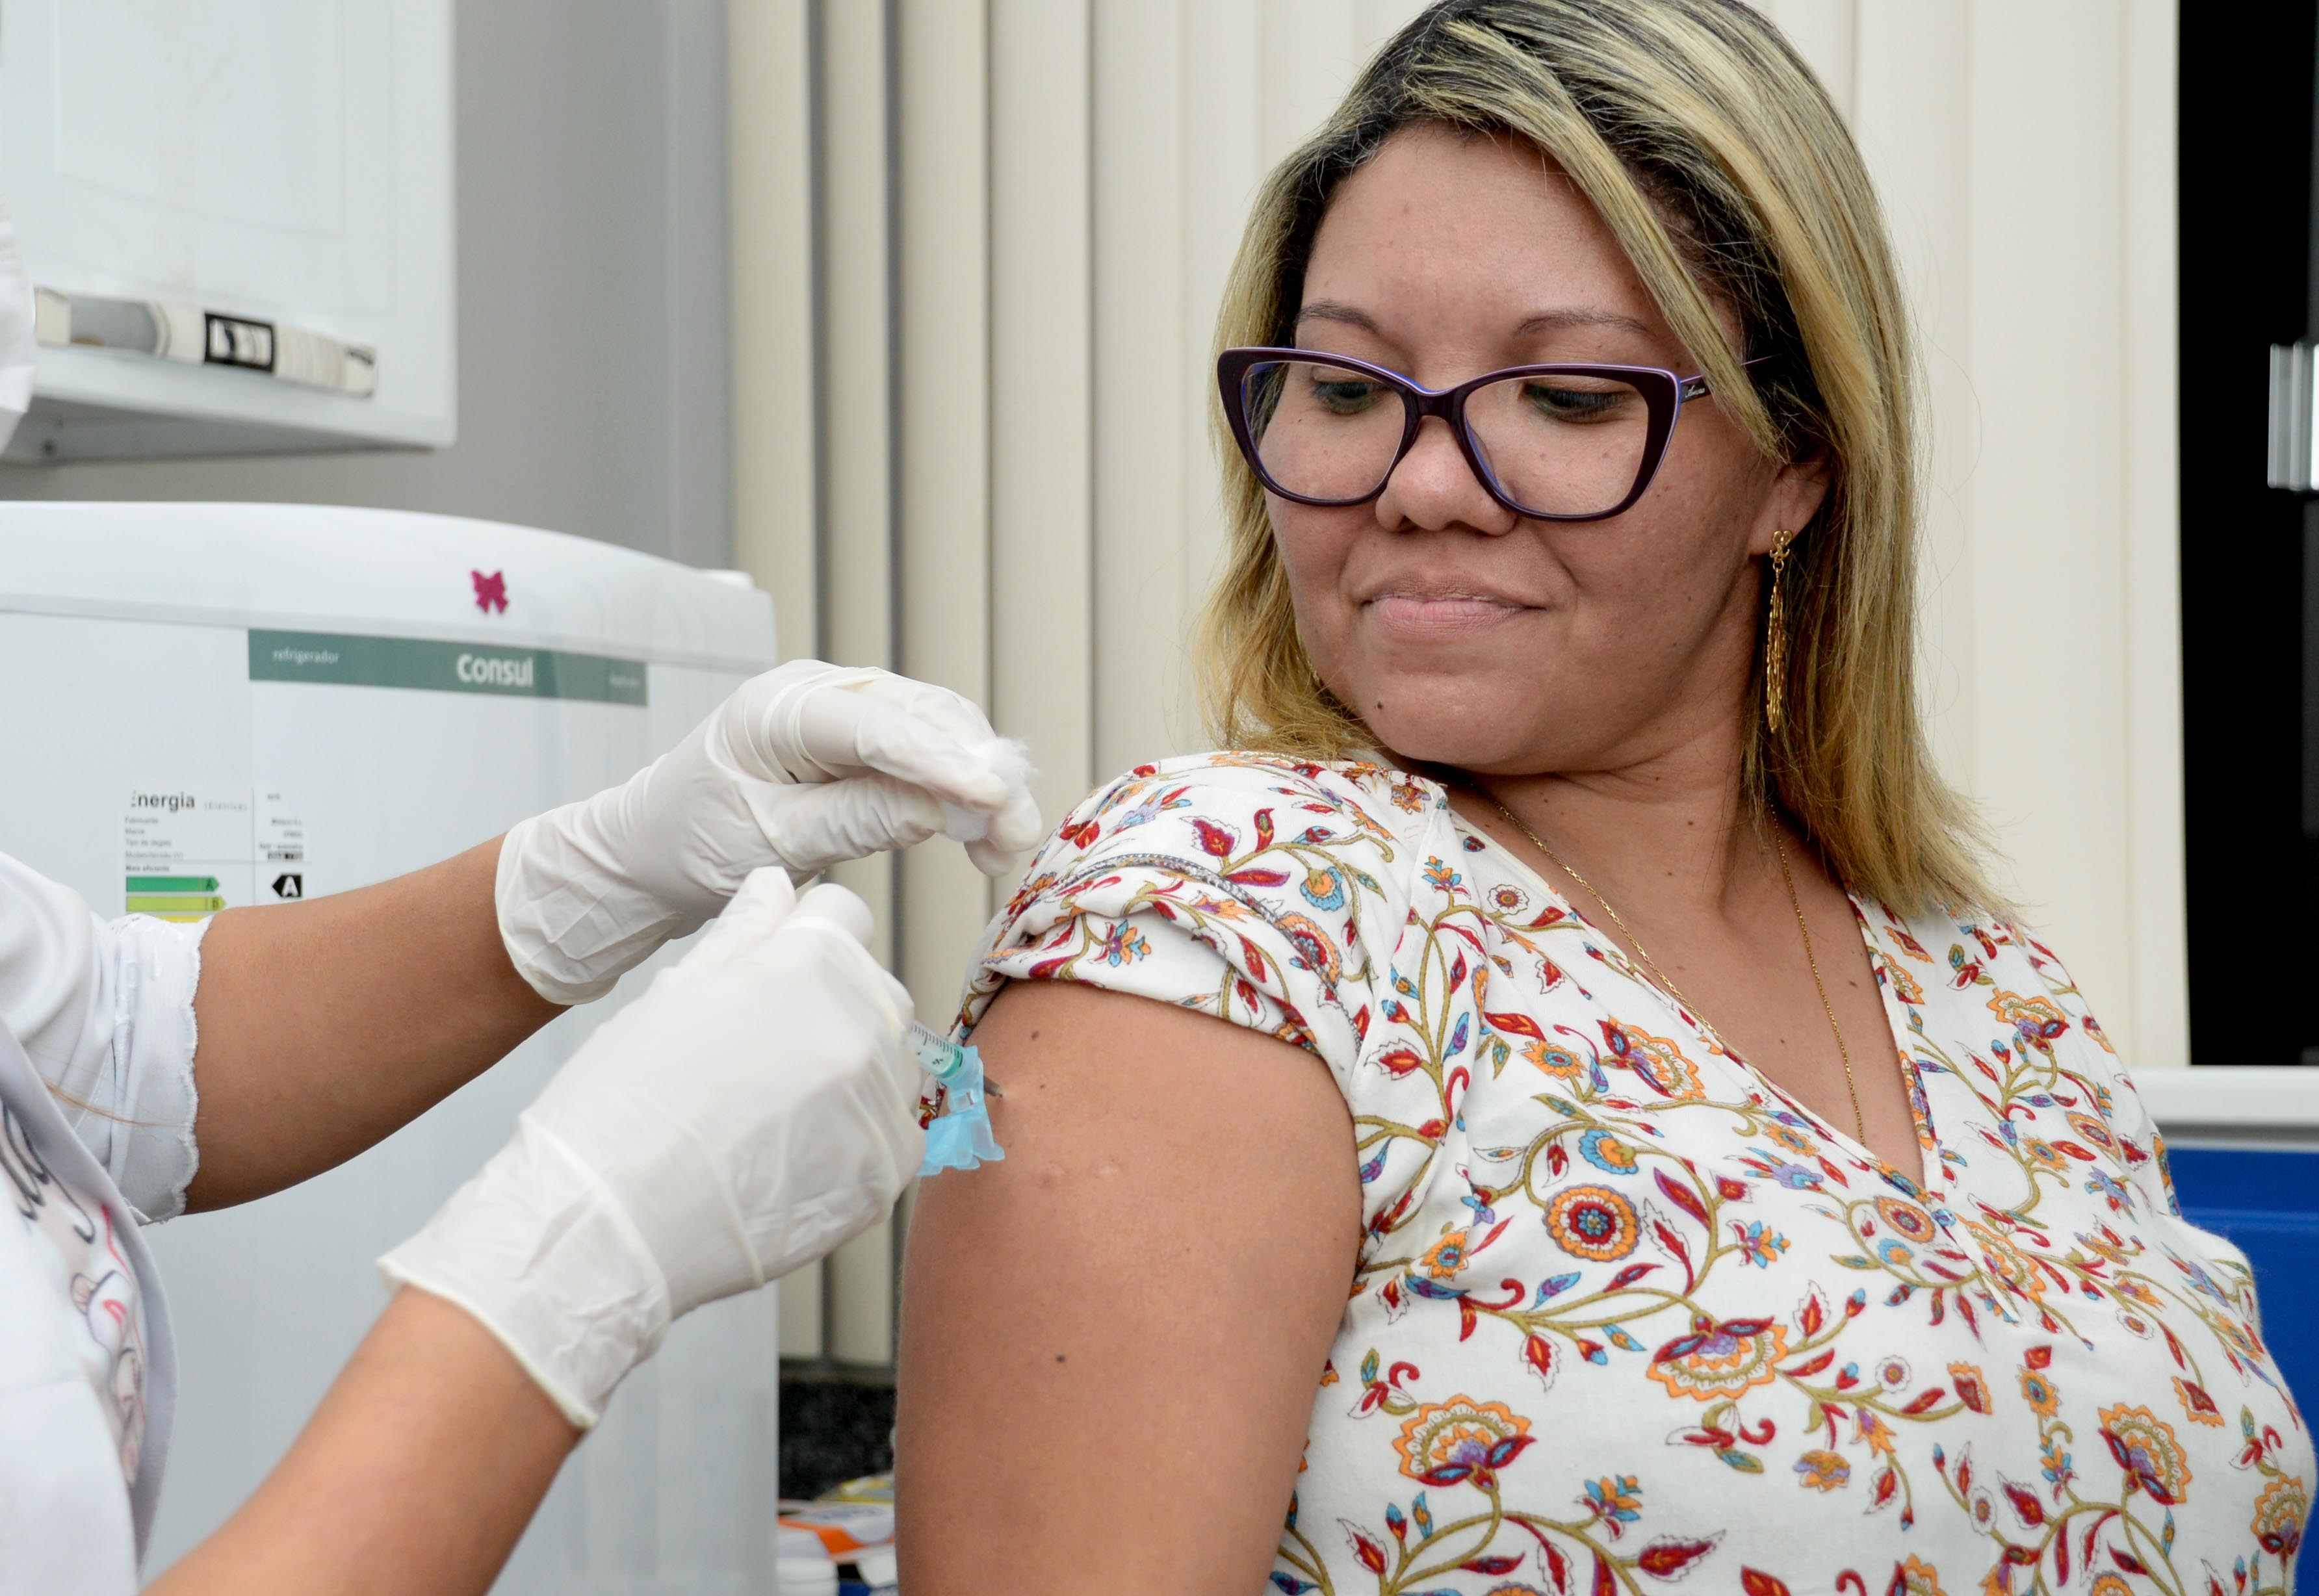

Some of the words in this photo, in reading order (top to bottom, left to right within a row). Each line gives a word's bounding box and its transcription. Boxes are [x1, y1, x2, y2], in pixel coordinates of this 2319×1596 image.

[272, 647, 339, 665] refrigerador
[457, 653, 534, 688] Consul
[205, 879, 214, 890] A
[281, 876, 300, 897] A
